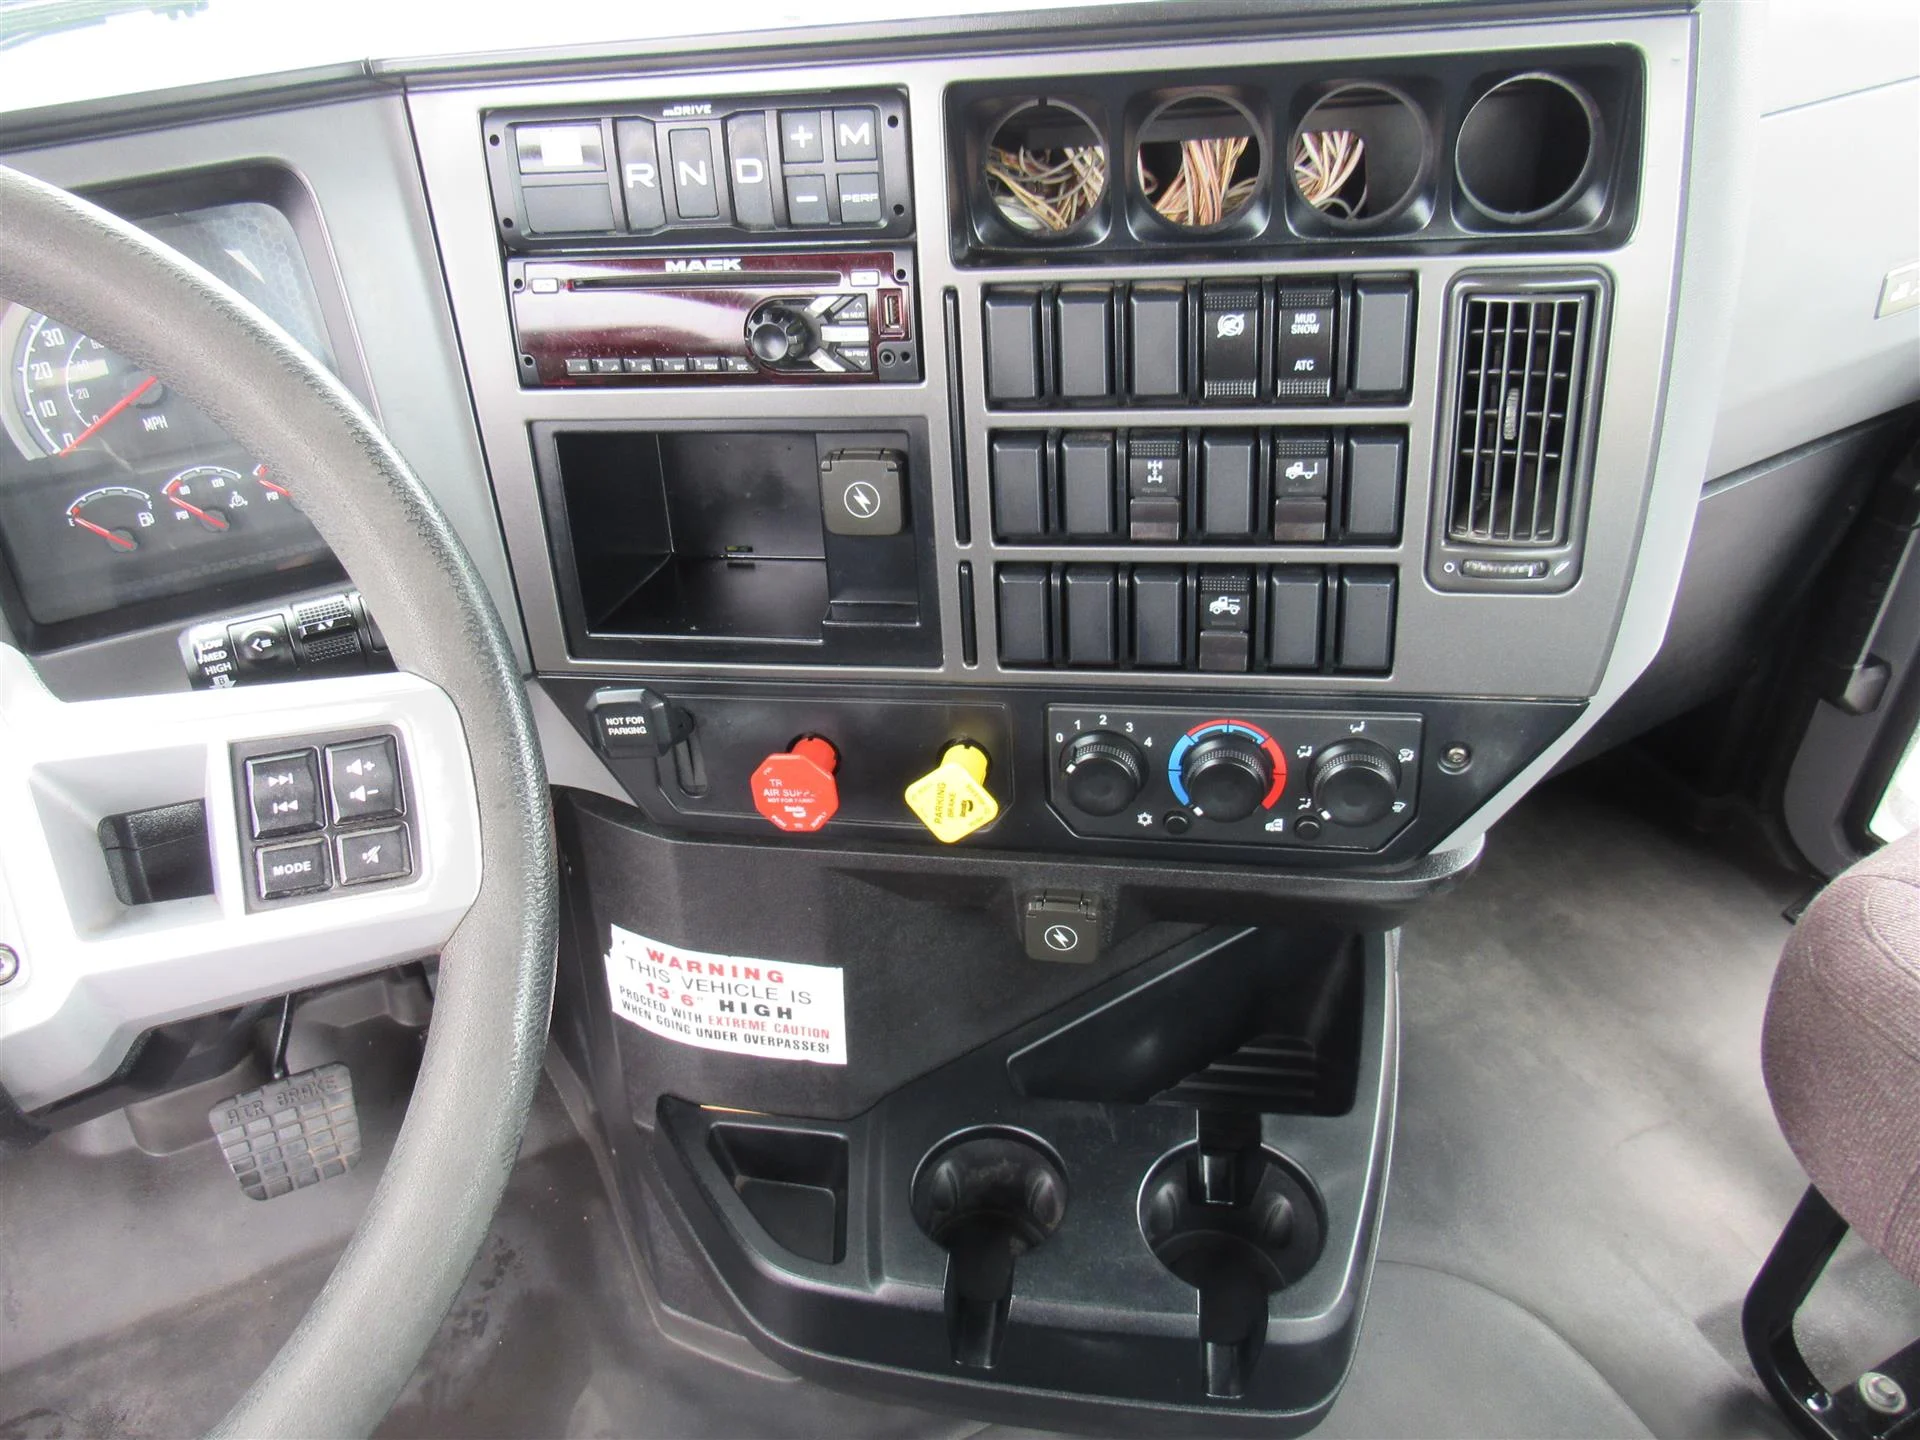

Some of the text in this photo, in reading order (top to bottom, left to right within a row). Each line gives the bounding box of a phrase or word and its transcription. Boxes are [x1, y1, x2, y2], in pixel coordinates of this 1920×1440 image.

[840, 122, 870, 147] M
[625, 163, 655, 188] R
[679, 160, 707, 186] N
[735, 158, 764, 184] D
[841, 192, 879, 203] PERF
[665, 258, 742, 272] MACK
[1294, 312, 1317, 324] MUD
[1290, 323, 1320, 335] SNOW
[42, 328, 65, 348] 30
[31, 361, 54, 381] 20
[1293, 359, 1315, 372] ATC
[76, 387, 90, 400] 20
[39, 400, 58, 418] 10
[142, 414, 169, 432] MPH
[203, 650, 228, 663] MED
[204, 661, 233, 676] HIGH
[605, 716, 645, 726] NOT FOR
[1074, 719, 1081, 730] 1
[1099, 714, 1108, 726] 2
[1125, 721, 1134, 733] 3
[608, 726, 648, 736] PARKING
[1055, 732, 1064, 743] 0
[1143, 736, 1153, 748] 4
[763, 788, 780, 797] AIR
[934, 782, 946, 825] PARKING
[272, 860, 312, 877] MODE
[646, 946, 784, 984] WARNING
[625, 955, 812, 1005] THIS VEHICLE IS
[619, 984, 830, 1039] PROCEED WITH EXTREME CAUTION
[719, 999, 793, 1020] HIGH
[621, 999, 830, 1054] WHEN GOING UNDER OVERPASSES!
[226, 1099, 265, 1125] AIR
